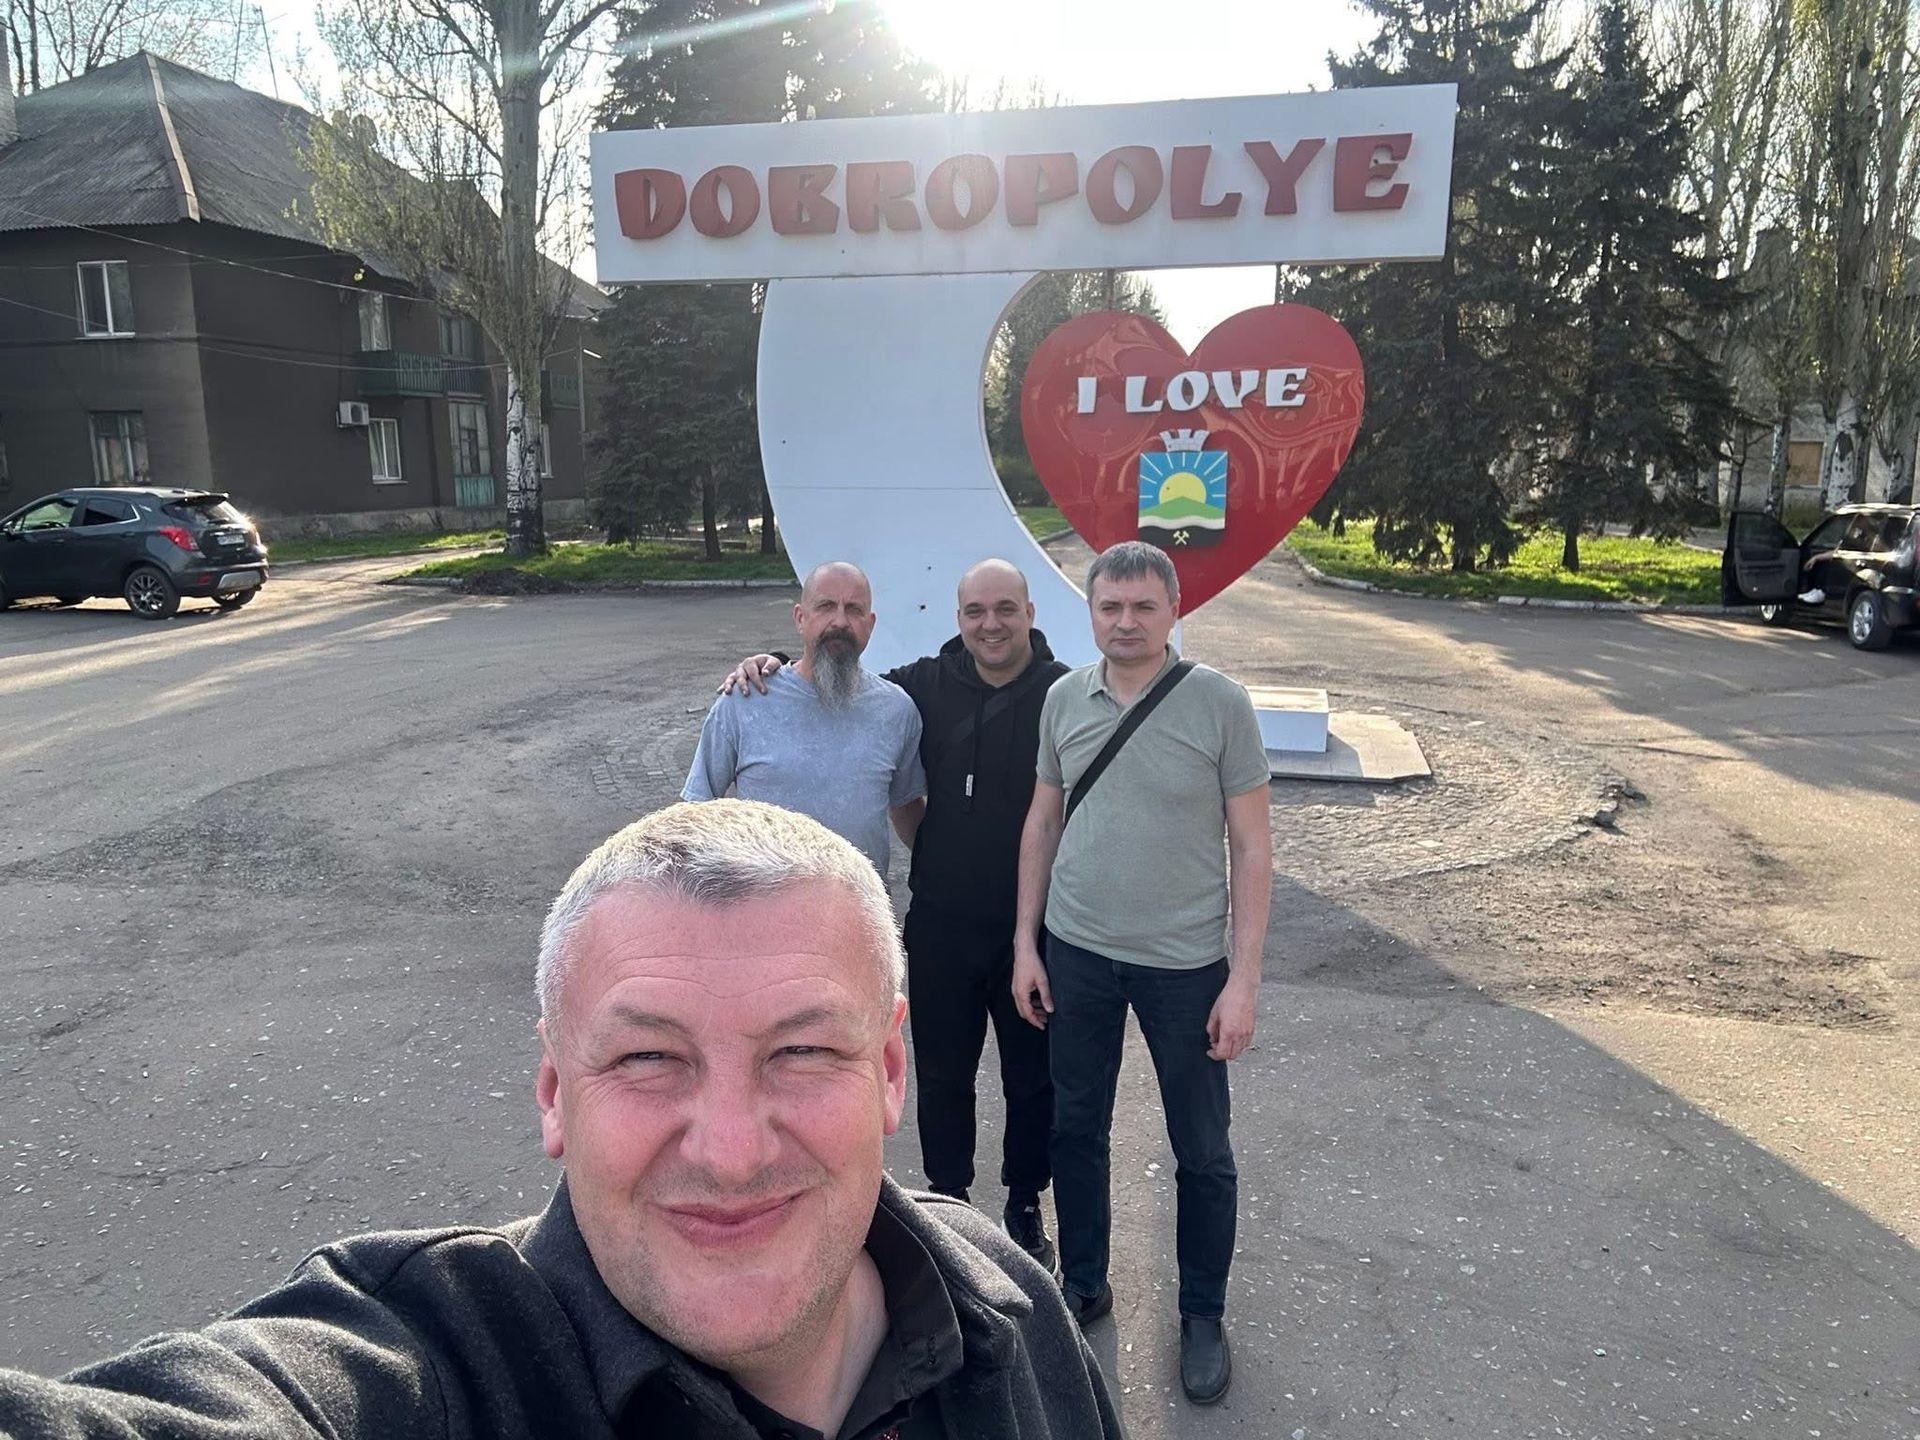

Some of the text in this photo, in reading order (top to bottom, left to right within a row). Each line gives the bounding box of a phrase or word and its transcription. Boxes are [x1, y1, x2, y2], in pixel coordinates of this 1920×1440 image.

[614, 133, 1413, 239] DOBROPOLYE
[1077, 367, 1308, 413] I LOVE
